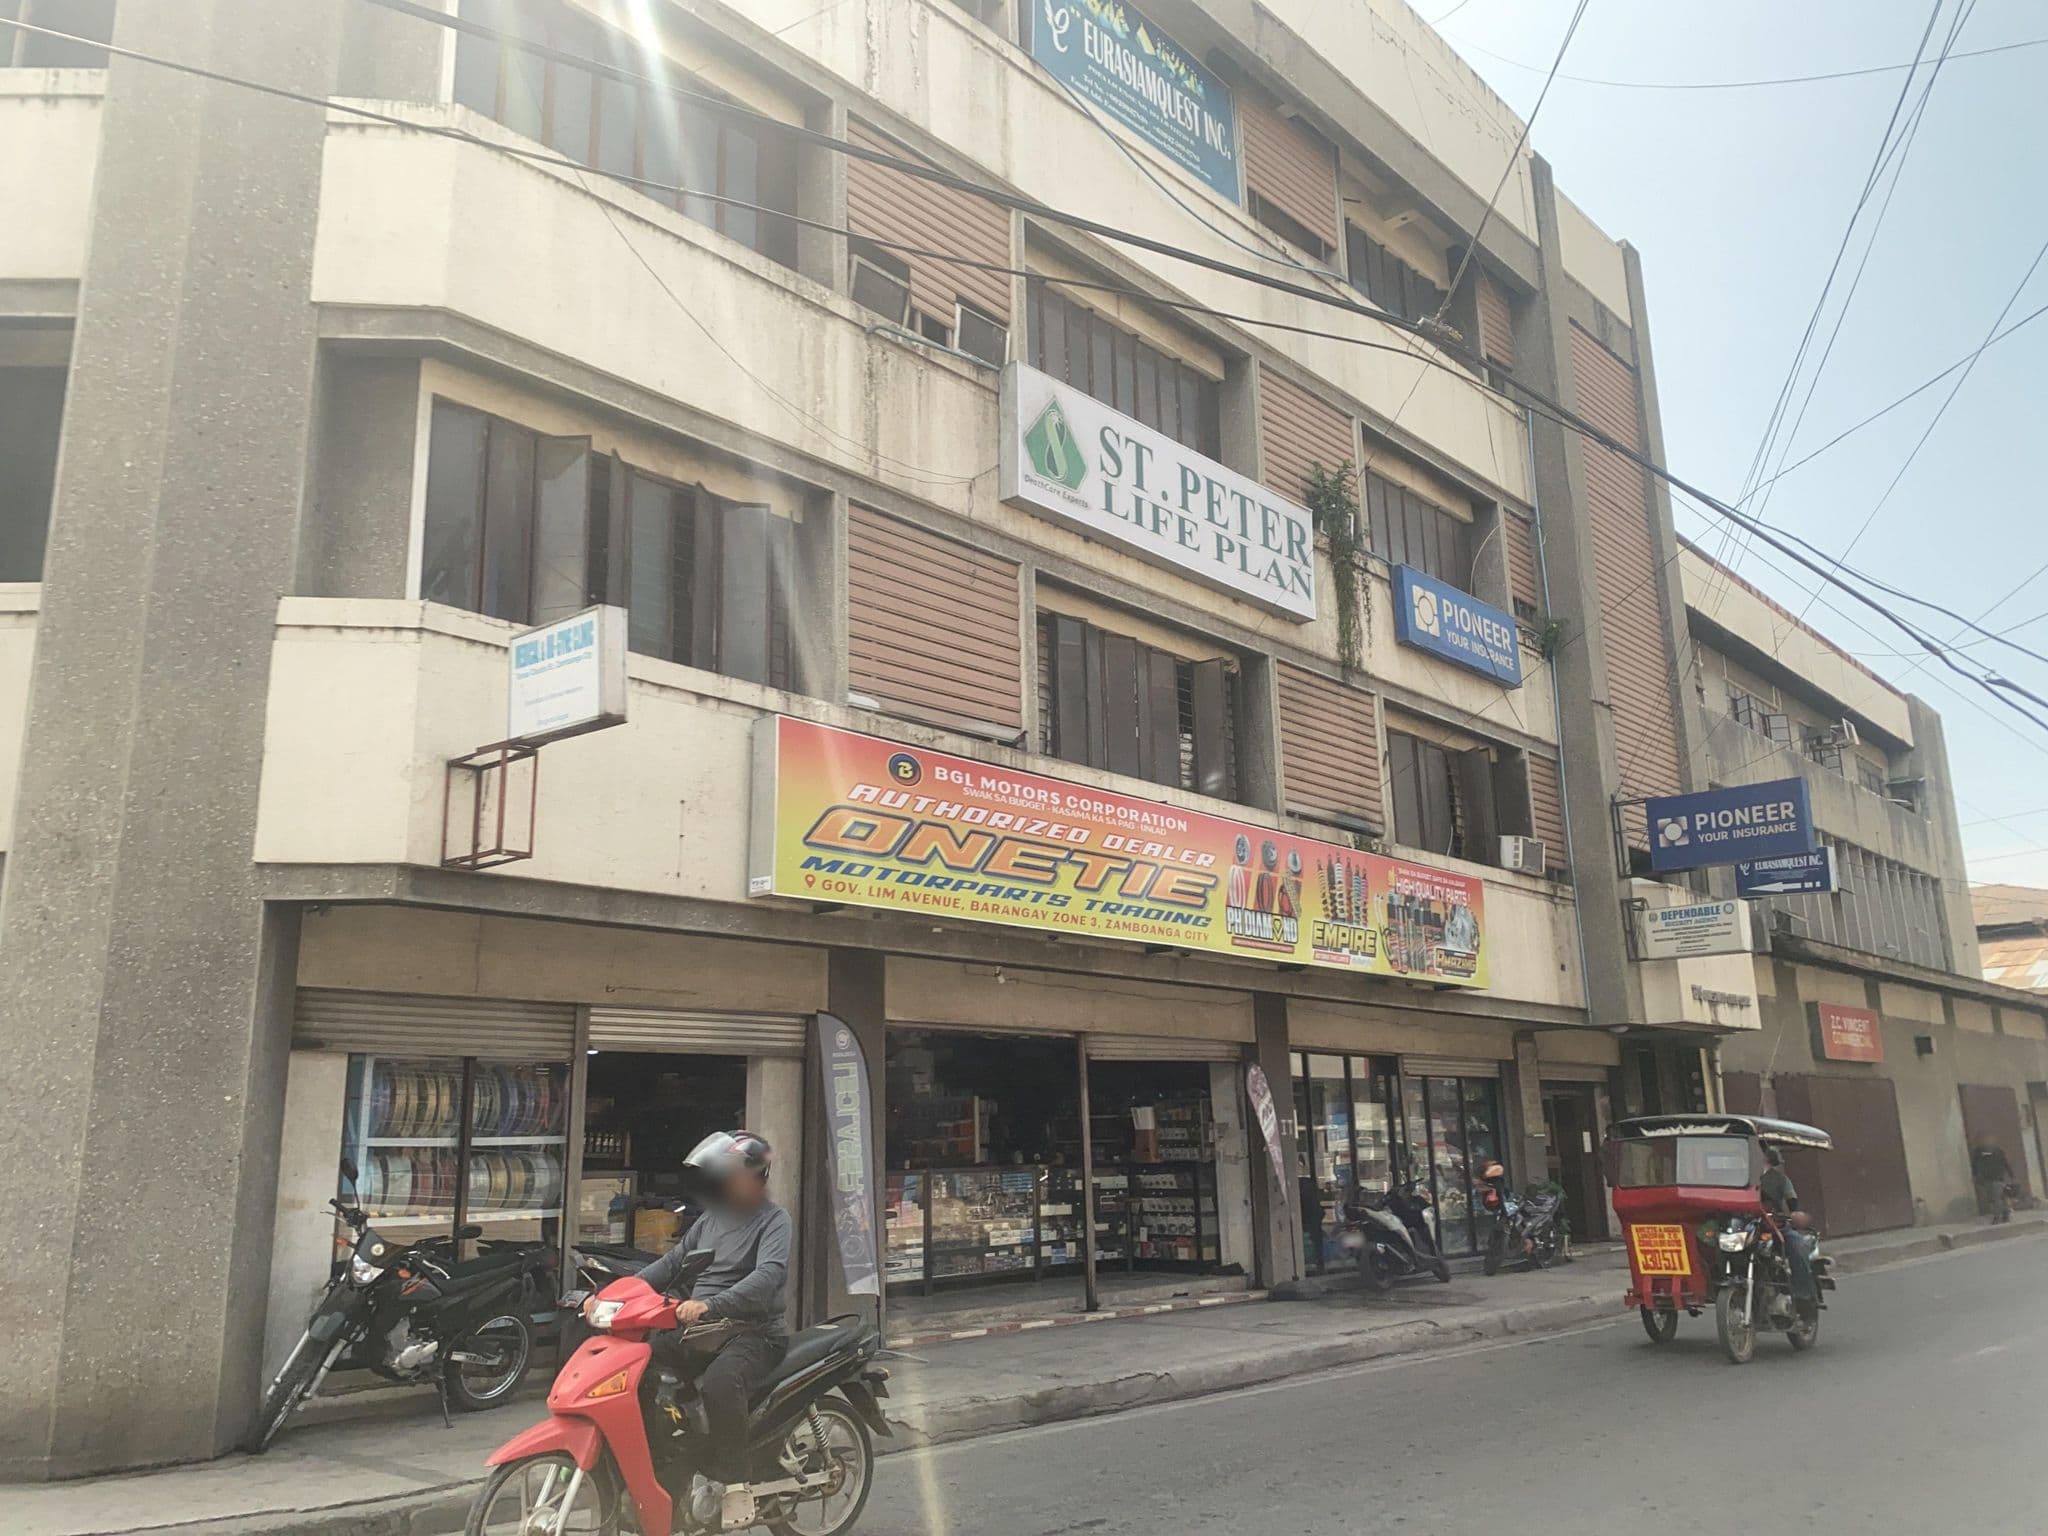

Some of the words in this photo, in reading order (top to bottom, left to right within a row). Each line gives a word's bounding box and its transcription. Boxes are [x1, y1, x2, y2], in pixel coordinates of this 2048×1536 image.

[1204, 111, 1232, 160] INC.
[1099, 425, 1168, 501] ST.
[1177, 462, 1312, 568] PETER
[1100, 480, 1200, 553] LIFE
[1214, 531, 1312, 602] PLAN
[1442, 598, 1513, 654] PIONEER
[1446, 629, 1470, 651] YOUR
[1471, 641, 1515, 671] INSURANCE
[934, 766, 974, 787] BGL
[981, 775, 1060, 805] MOTORS
[1066, 796, 1188, 832] CORPORATION
[963, 787, 993, 801] SWAK
[994, 795, 1008, 804] SA
[1009, 797, 1046, 811] BUDGET
[1052, 806, 1090, 821] KASAMA
[1695, 801, 1796, 831] PIONEER
[847, 783, 1092, 845] AUTHORIZED
[1102, 834, 1216, 868] DEALER
[1697, 831, 1729, 843] YOUR
[1732, 821, 1797, 840] INSURANCE
[803, 804, 1219, 911] ONETIE
[799, 856, 1072, 907] MOTORPARTS
[1086, 898, 1213, 928] TRADING
[822, 878, 861, 896] GOV.
[867, 885, 895, 901] LIM
[900, 891, 965, 912] AVENUE,
[970, 900, 1048, 920] BARANGAY
[1053, 911, 1086, 927] ZONE
[1105, 917, 1181, 939] ZAMBOANGA
[1184, 929, 1210, 943] CITY
[1396, 877, 1414, 895] HIGH
[1415, 882, 1444, 901] QUALITY
[1445, 887, 1467, 906] PARTS
[1661, 905, 1720, 921] DEPENDABLE
[1226, 906, 1243, 934] PH
[1312, 920, 1377, 957] EMPIRE
